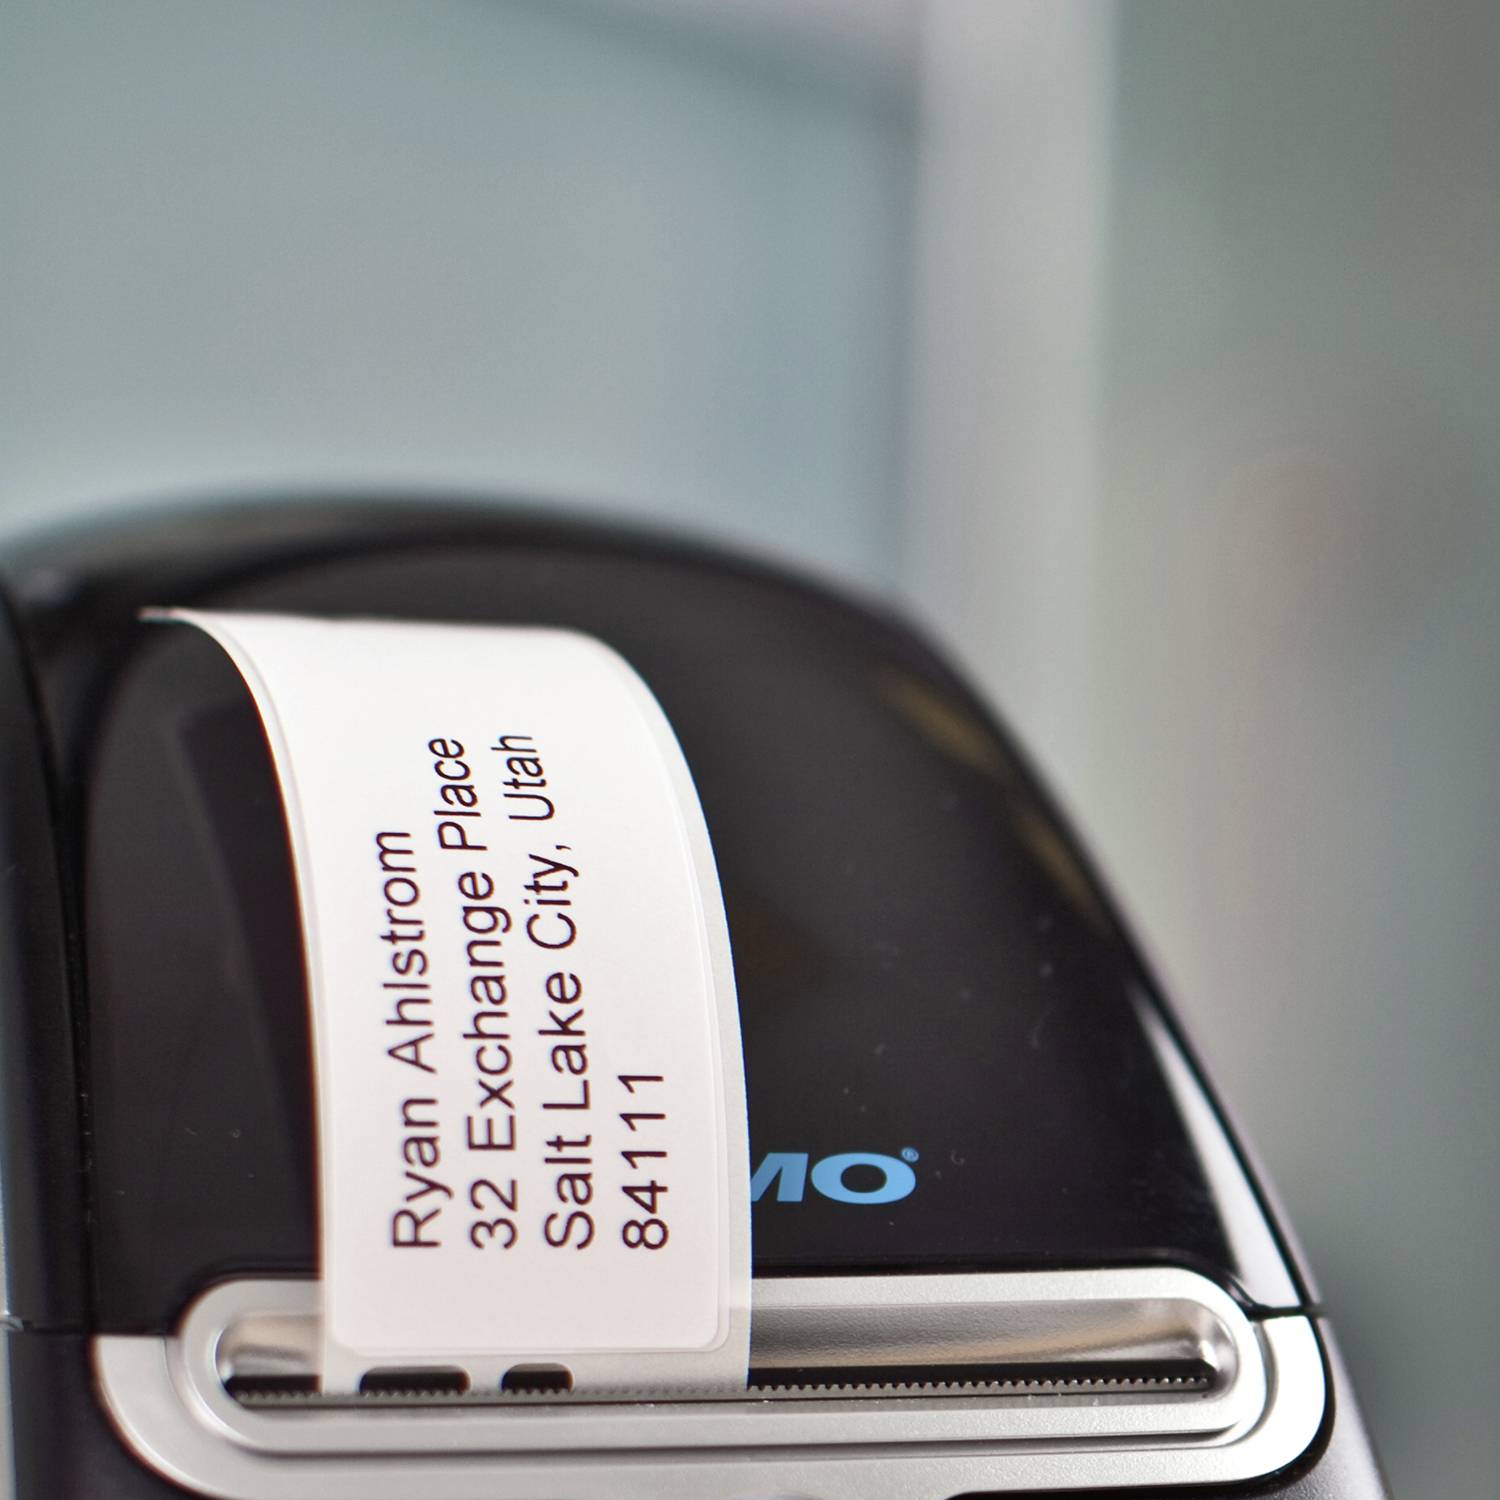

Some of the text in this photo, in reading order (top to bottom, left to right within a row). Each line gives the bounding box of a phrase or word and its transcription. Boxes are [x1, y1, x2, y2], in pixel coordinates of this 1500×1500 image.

[375, 831, 453, 1248] Ryan Ahlstrom
[427, 738, 518, 1250] 32 Exchange Place
[490, 734, 595, 1251] Salt Lake City, Utah
[617, 1074, 670, 1251] 84111
